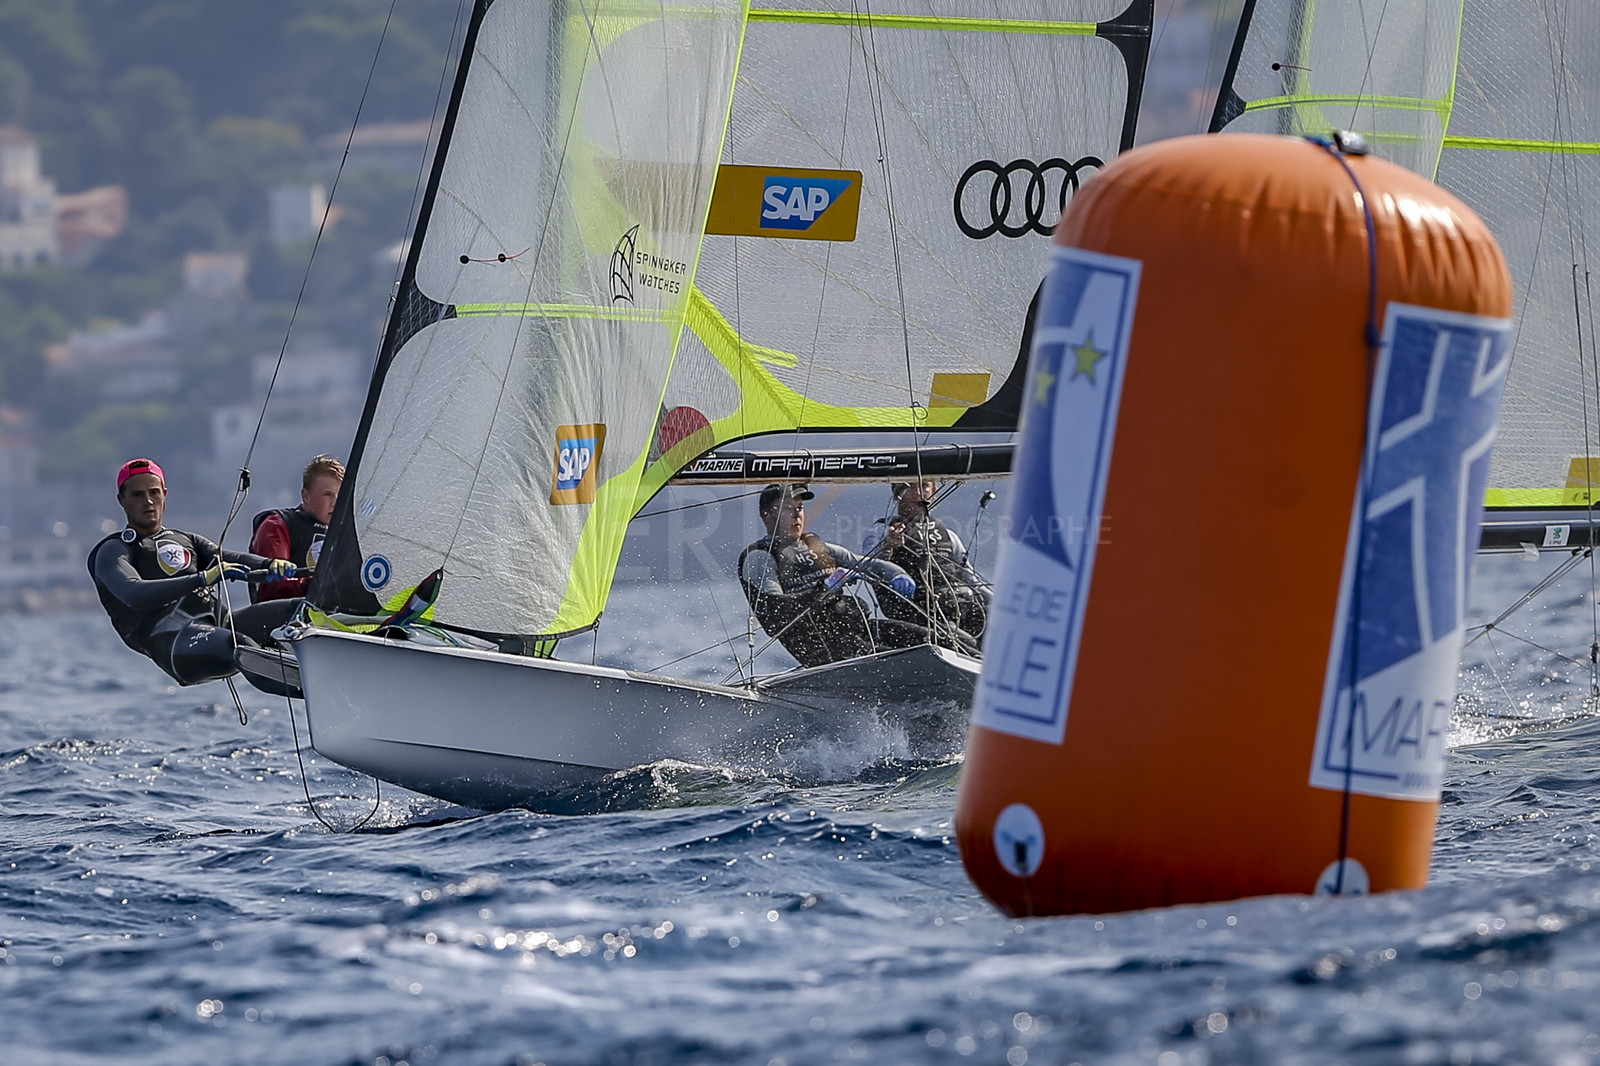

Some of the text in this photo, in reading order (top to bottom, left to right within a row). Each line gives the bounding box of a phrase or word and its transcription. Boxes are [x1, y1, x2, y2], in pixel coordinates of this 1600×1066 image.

[762, 185, 830, 222] SAP
[557, 447, 590, 481] SAP
[695, 460, 743, 472] MARINE
[1025, 584, 1068, 624] DE
